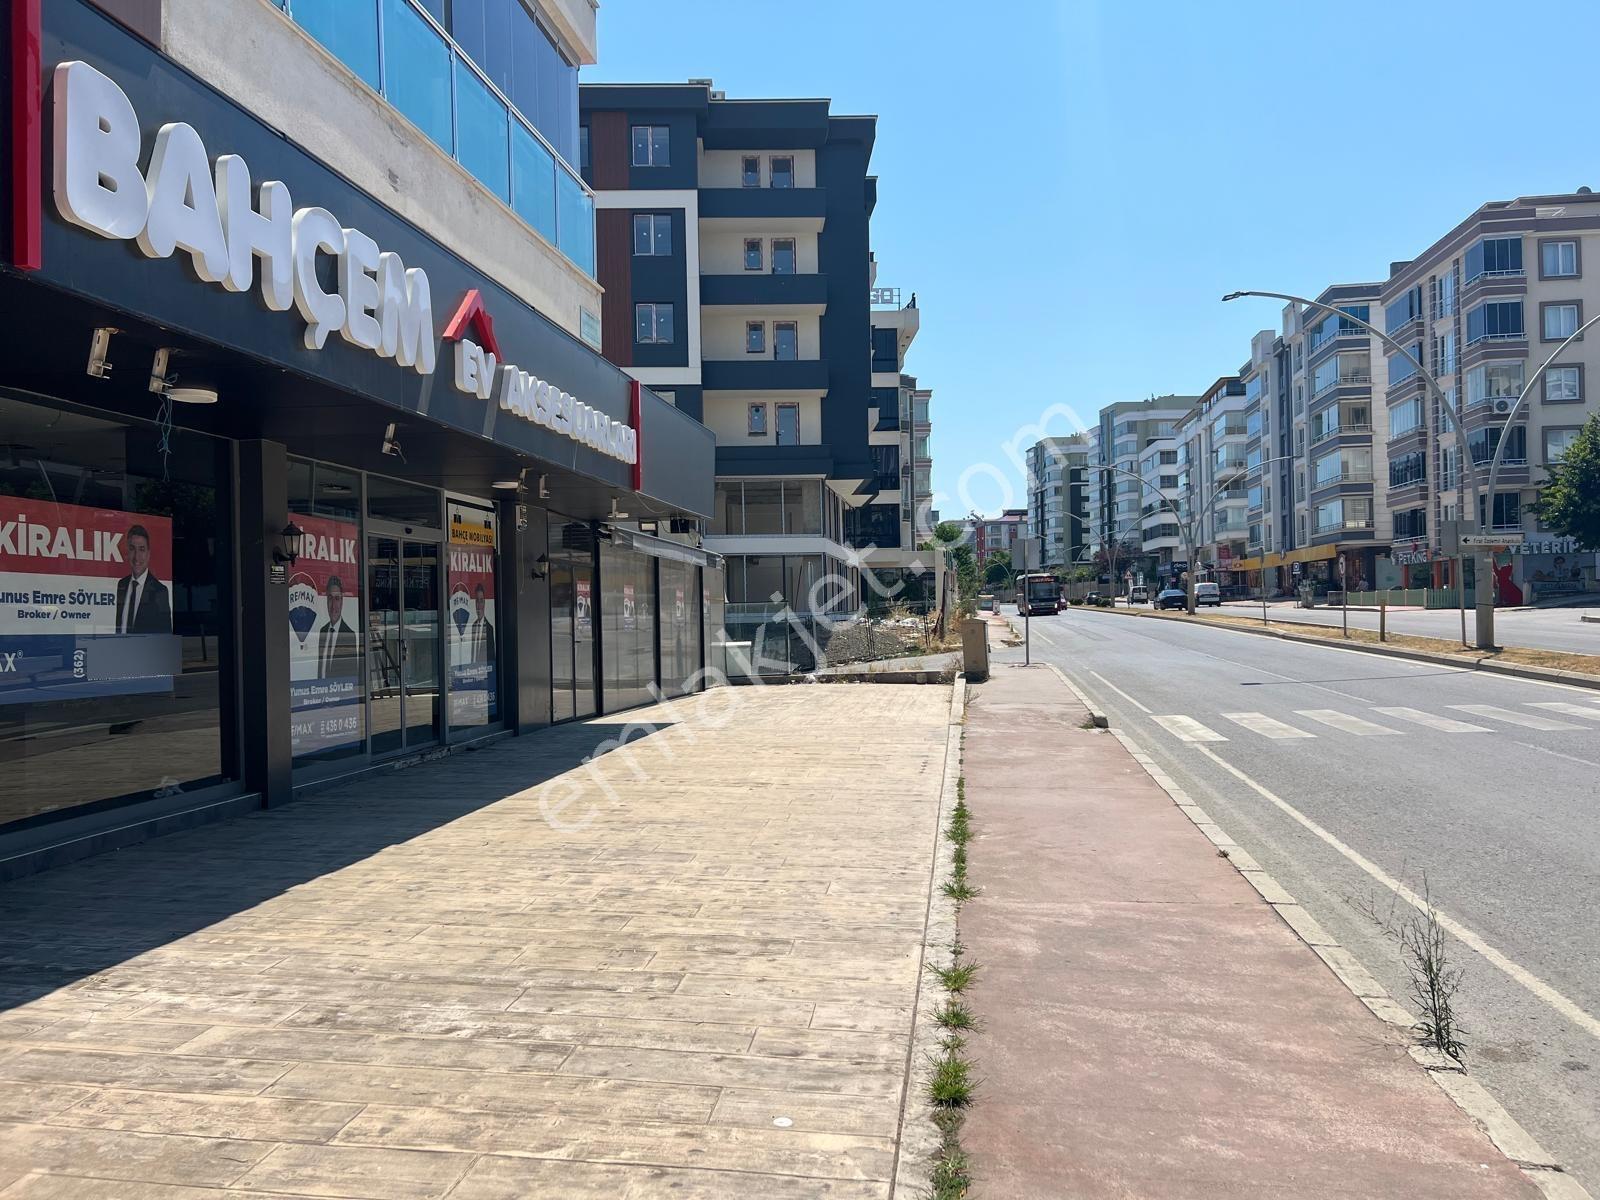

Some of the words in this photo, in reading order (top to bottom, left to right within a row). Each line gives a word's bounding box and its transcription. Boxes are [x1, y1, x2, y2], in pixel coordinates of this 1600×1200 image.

[53, 60, 436, 375] BAHÇEM
[455, 338, 498, 400] EV
[499, 364, 637, 465] AKSESUARLARI
[0, 513, 124, 562] KİRALIK
[297, 526, 356, 564] İRALIK
[450, 547, 493, 573] KİRALIK
[32, 590, 66, 605] Emre
[68, 589, 115, 606] SÖYLER
[17, 610, 51, 619] Broker
[60, 611, 91, 619] Owner
[73, 650, 85, 678] (362)
